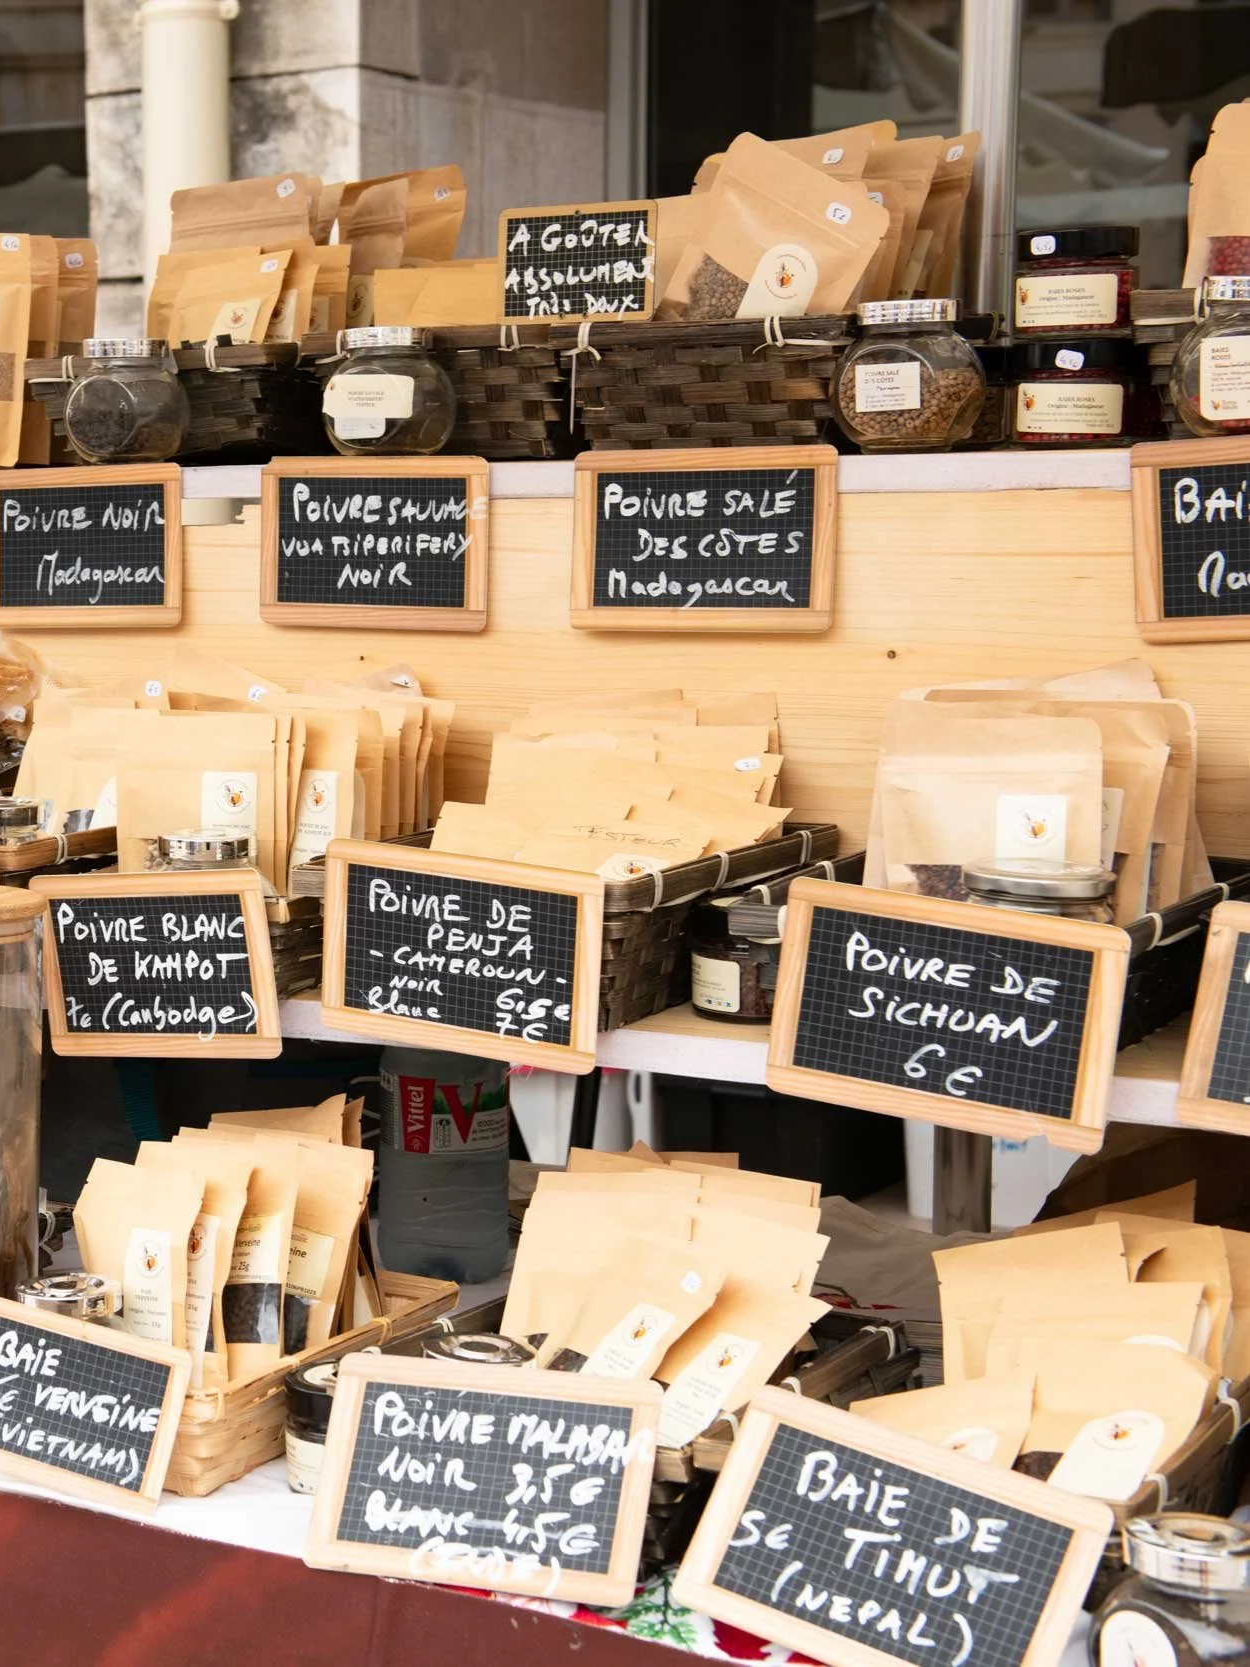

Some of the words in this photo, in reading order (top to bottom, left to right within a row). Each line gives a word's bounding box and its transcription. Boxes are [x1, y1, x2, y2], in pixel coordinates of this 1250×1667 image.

[508, 224, 531, 257] A
[722, 469, 799, 519] SALÉ
[1174, 478, 1250, 525] BAI
[632, 527, 689, 562] DES
[36, 550, 166, 604] Madagascar
[608, 567, 796, 609] Madagascar
[162, 912, 246, 942] BLANC
[486, 898, 533, 932] DE
[427, 922, 535, 960] PENJA
[88, 952, 119, 985] DE
[135, 950, 250, 982] KAMPOT
[393, 946, 547, 985] CAMEROUN
[990, 965, 1061, 1004] DE
[102, 991, 259, 1041] (Cambodge)
[406, 1085, 426, 1133] Vittel
[934, 1506, 1009, 1553] DE
